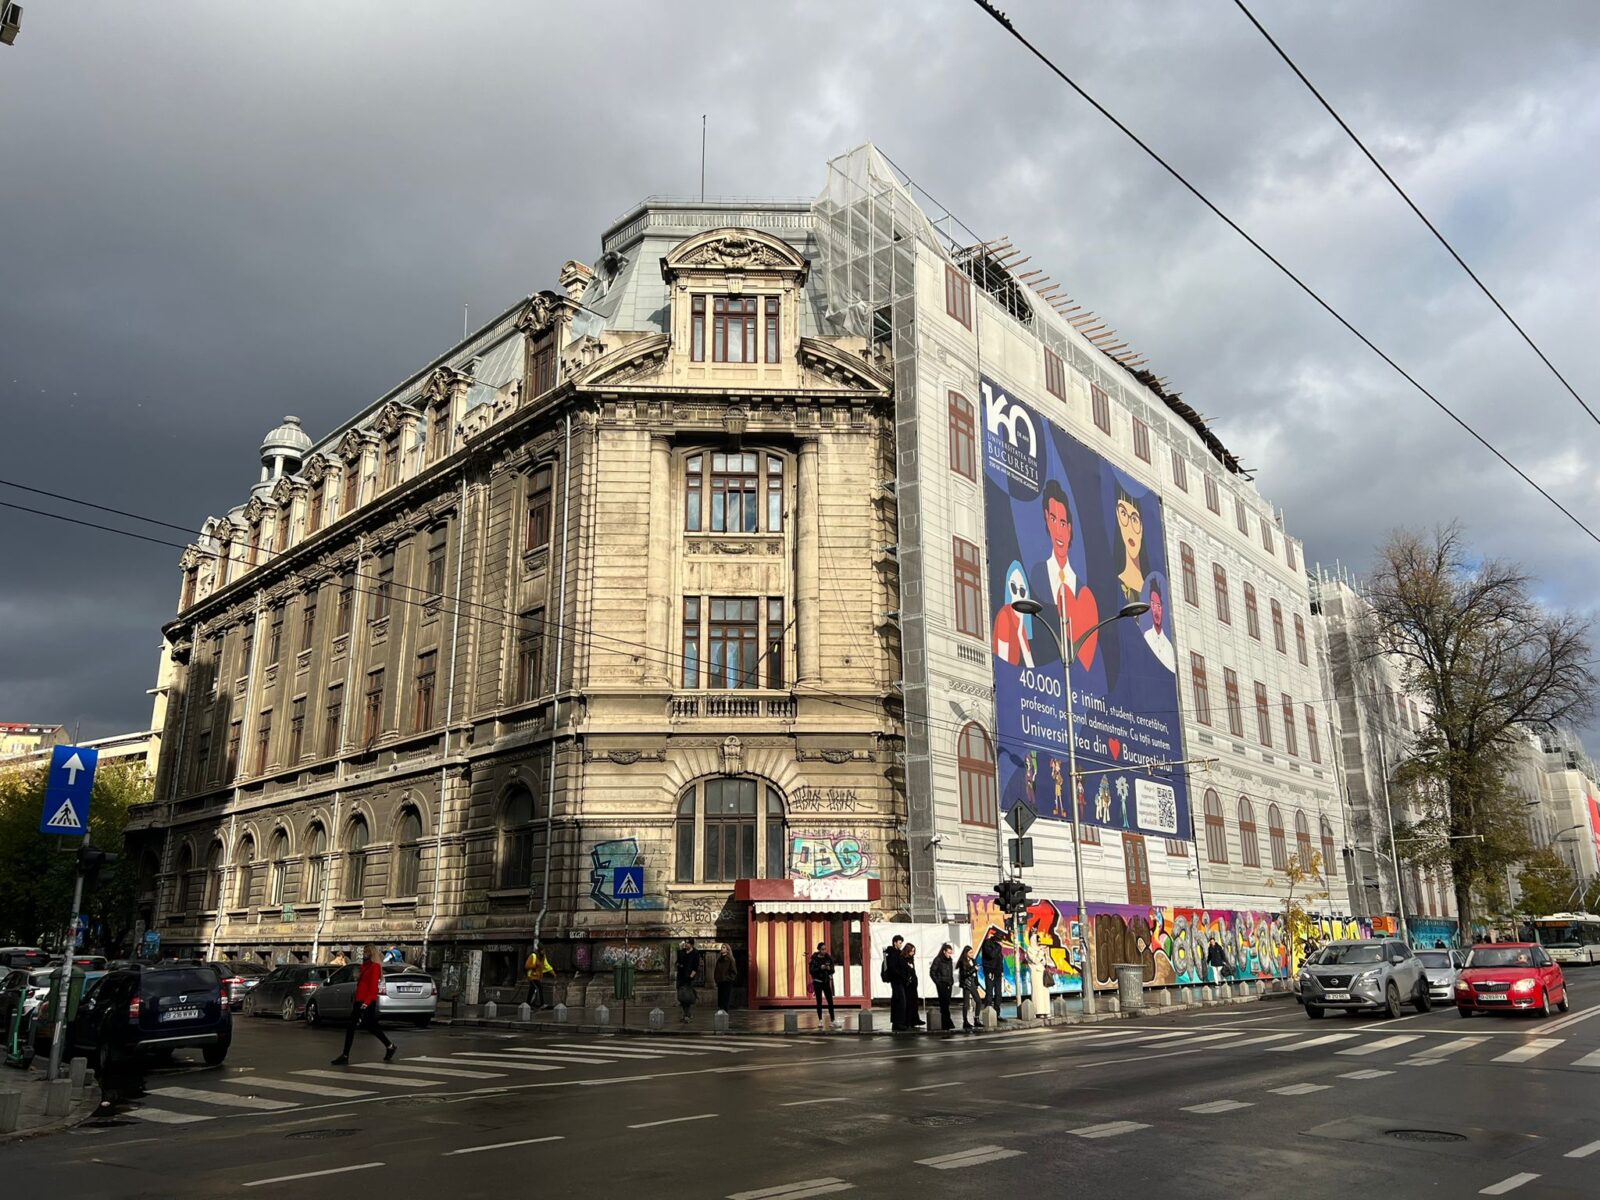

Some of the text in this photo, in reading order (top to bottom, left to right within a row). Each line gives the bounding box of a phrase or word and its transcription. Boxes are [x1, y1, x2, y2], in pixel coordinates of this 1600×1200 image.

[987, 441, 1039, 481] BUCUREȘTI
[1019, 669, 1061, 698] 40.000
[1081, 689, 1108, 717] inimi,
[1110, 705, 1136, 725] studenți,
[1136, 715, 1170, 736] cercetători,
[1020, 695, 1058, 719] profesori,
[1088, 715, 1130, 739] administrativ.
[1129, 727, 1139, 742] Cu
[1151, 737, 1171, 751] suntem
[1021, 713, 1091, 750] Universittea
[1093, 734, 1108, 755] din
